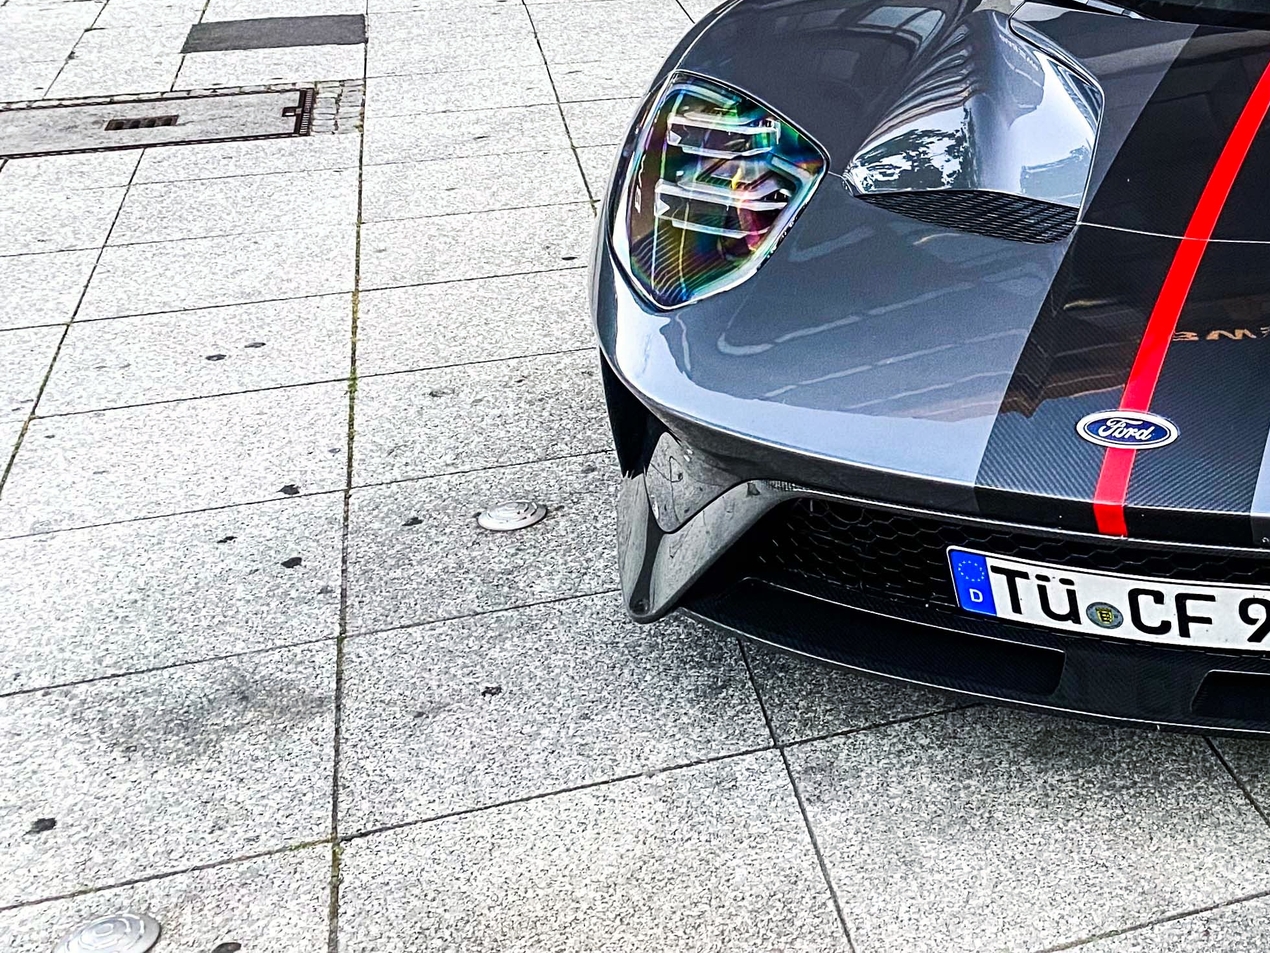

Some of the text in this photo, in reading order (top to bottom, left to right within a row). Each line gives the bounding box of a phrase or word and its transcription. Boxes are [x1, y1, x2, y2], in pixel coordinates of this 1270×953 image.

[1098, 418, 1155, 441] Ford
[970, 588, 983, 604] D
[990, 564, 1083, 626] TÜ
[1127, 587, 1218, 639] CF
